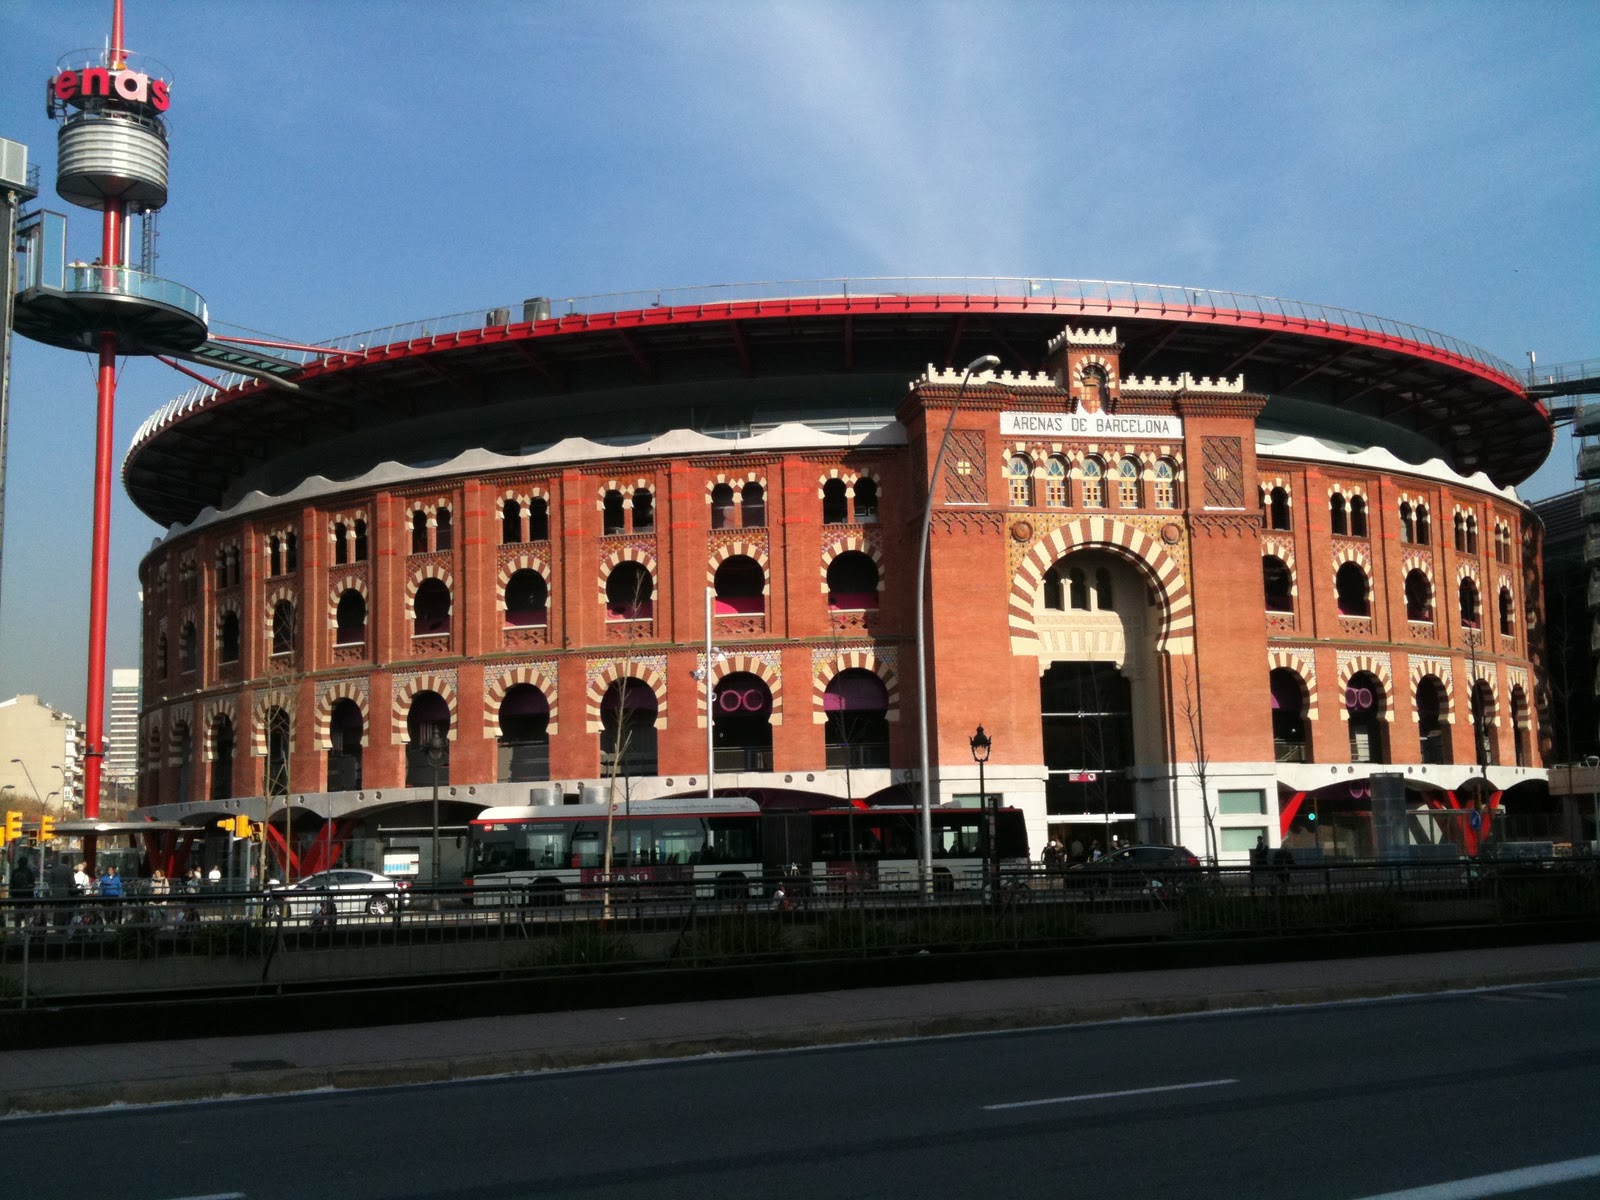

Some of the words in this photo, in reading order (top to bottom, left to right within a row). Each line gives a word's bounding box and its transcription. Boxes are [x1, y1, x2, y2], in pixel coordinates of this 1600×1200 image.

[1013, 416, 1062, 431] ARENAS
[1071, 417, 1087, 432] DE
[1096, 418, 1170, 434] BARCELONA
